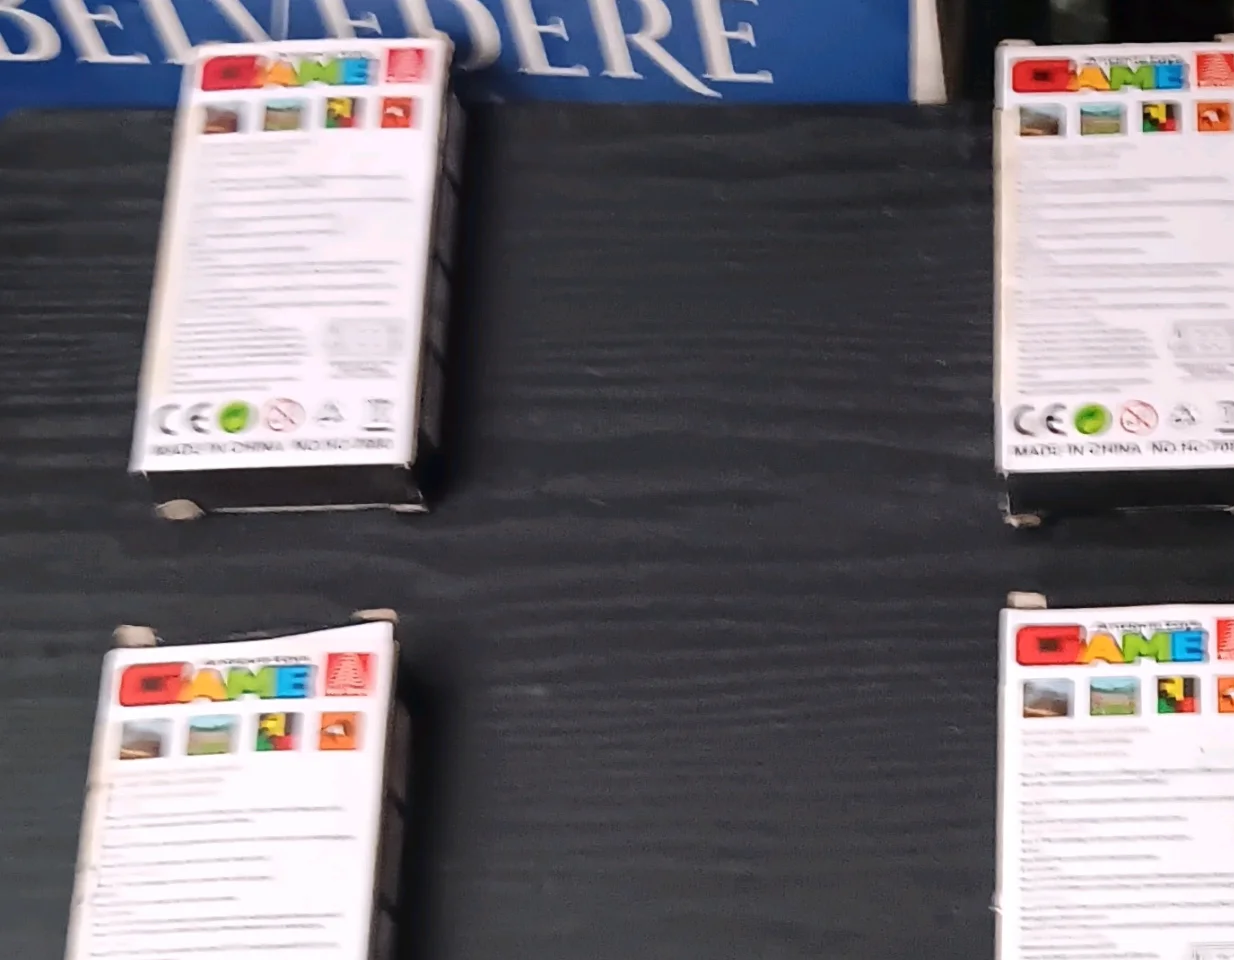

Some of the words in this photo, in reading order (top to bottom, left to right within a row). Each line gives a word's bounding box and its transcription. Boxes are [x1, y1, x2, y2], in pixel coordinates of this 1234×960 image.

[1066, 445, 1086, 457] IN
[1016, 624, 1209, 666] GAME
[119, 661, 317, 707] GAME
